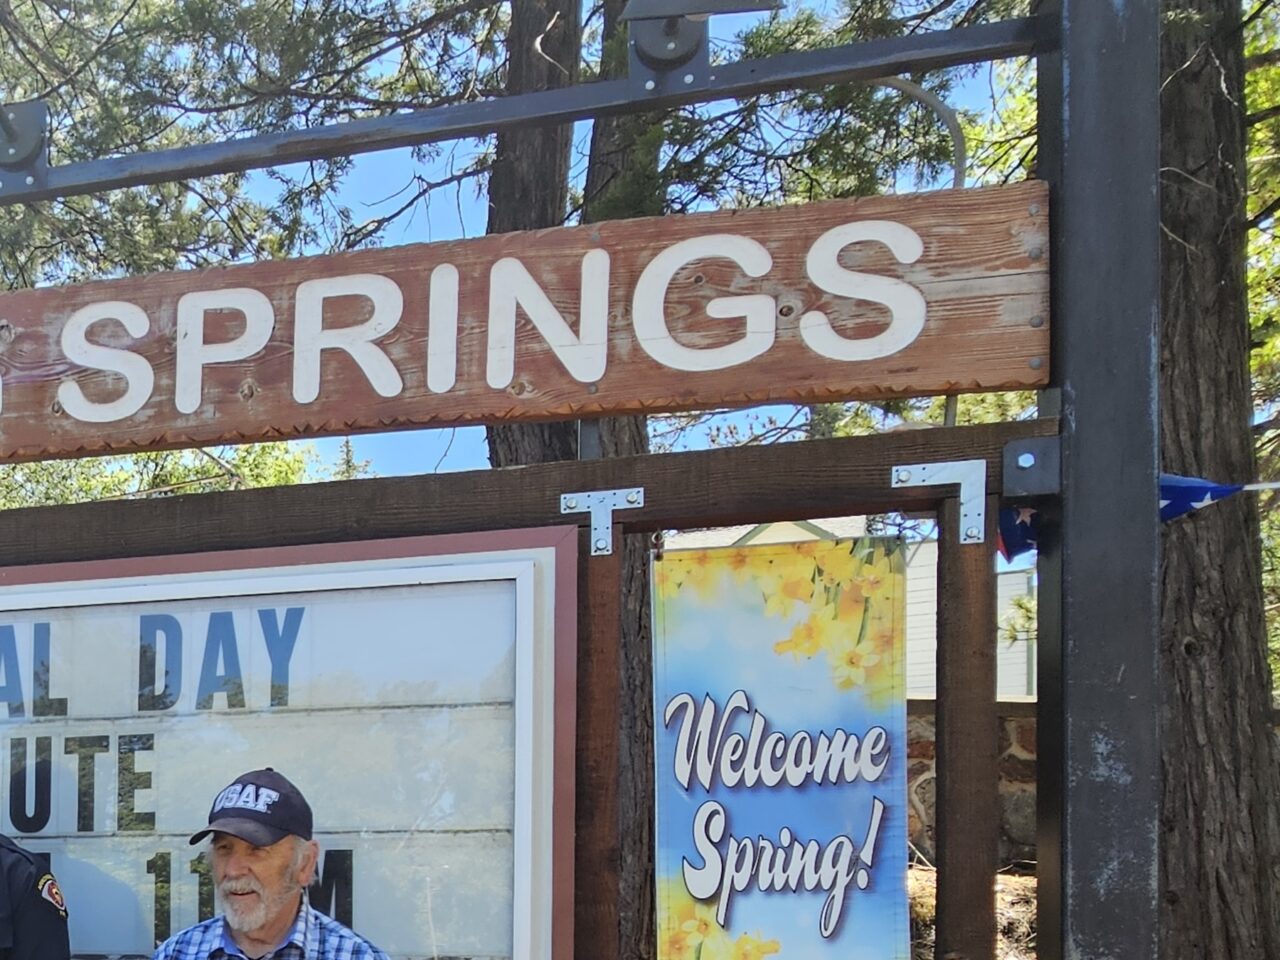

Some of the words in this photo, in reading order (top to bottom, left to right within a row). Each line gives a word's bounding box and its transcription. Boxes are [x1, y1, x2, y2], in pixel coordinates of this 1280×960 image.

[56, 220, 928, 424] SPRINGS
[138, 606, 306, 712] DAY
[663, 689, 890, 793] Welcome
[212, 782, 281, 814] USAF
[146, 849, 354, 950] 11M
[681, 796, 886, 941] Spring!
